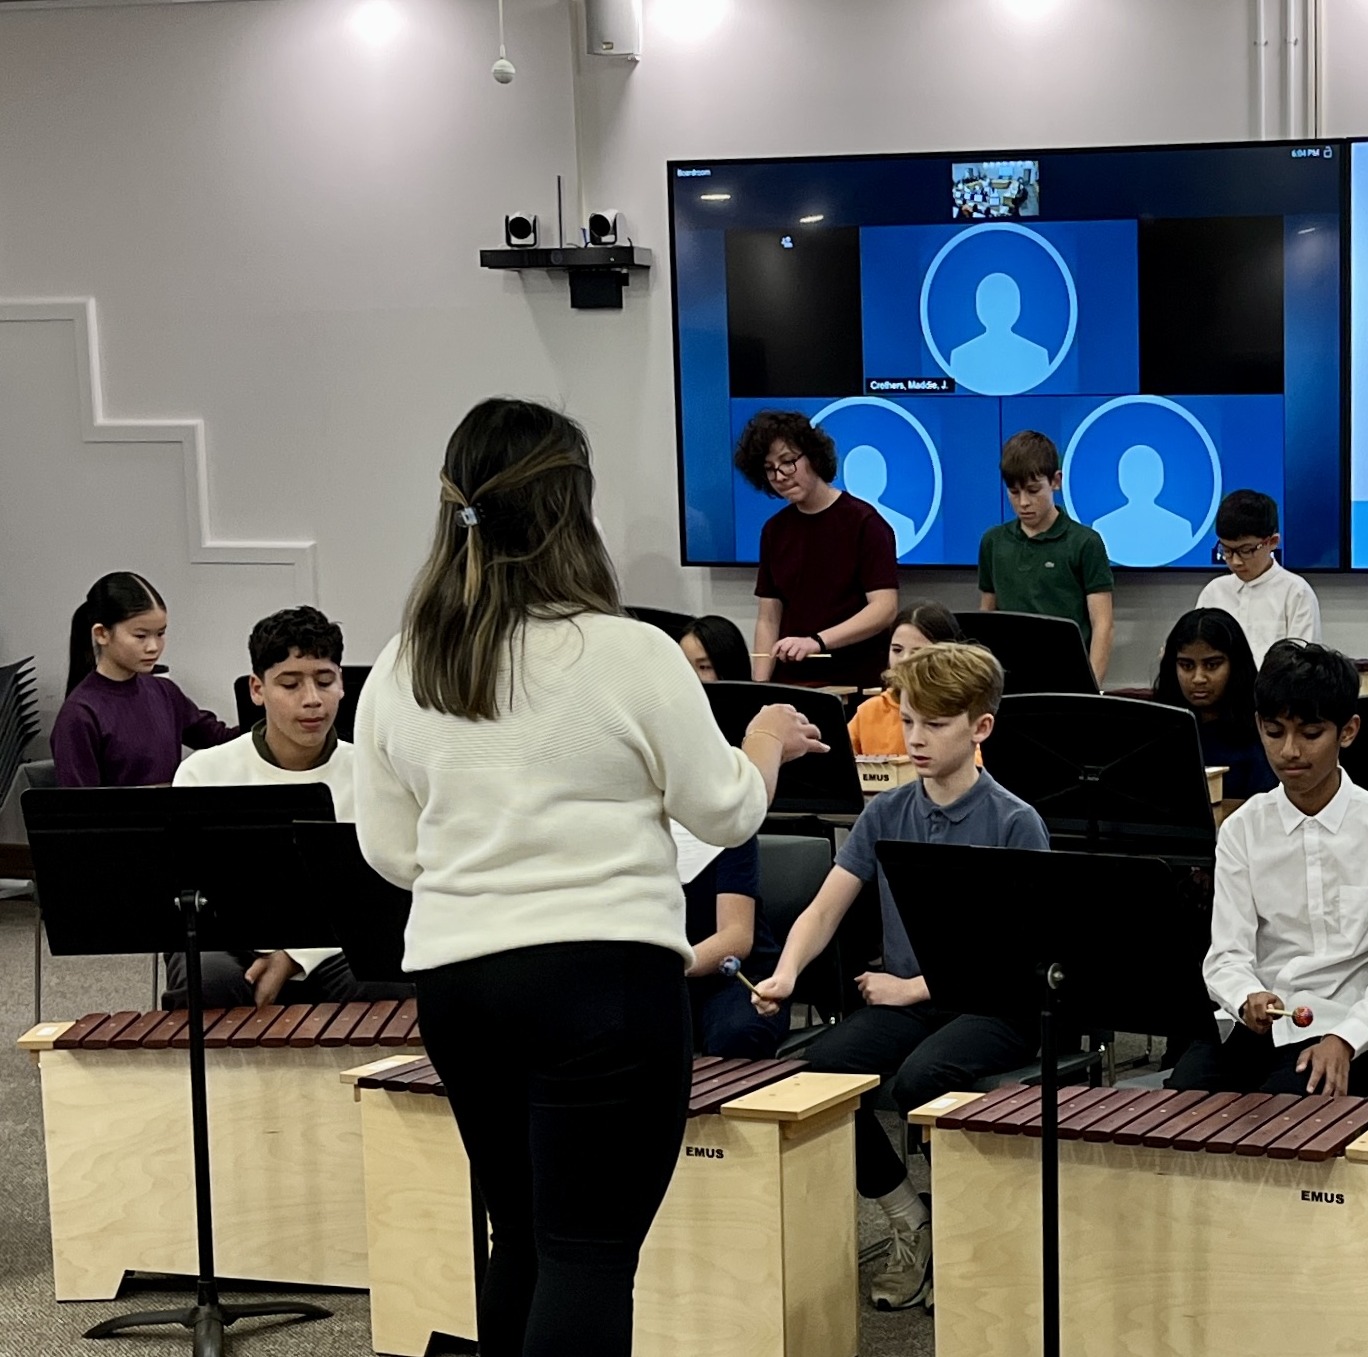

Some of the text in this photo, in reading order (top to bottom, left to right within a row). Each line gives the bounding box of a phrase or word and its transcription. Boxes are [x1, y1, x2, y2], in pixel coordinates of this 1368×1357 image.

[863, 773, 889, 782] EMUS
[685, 1146, 724, 1159] EMUS
[1301, 1190, 1345, 1205] EMUS
